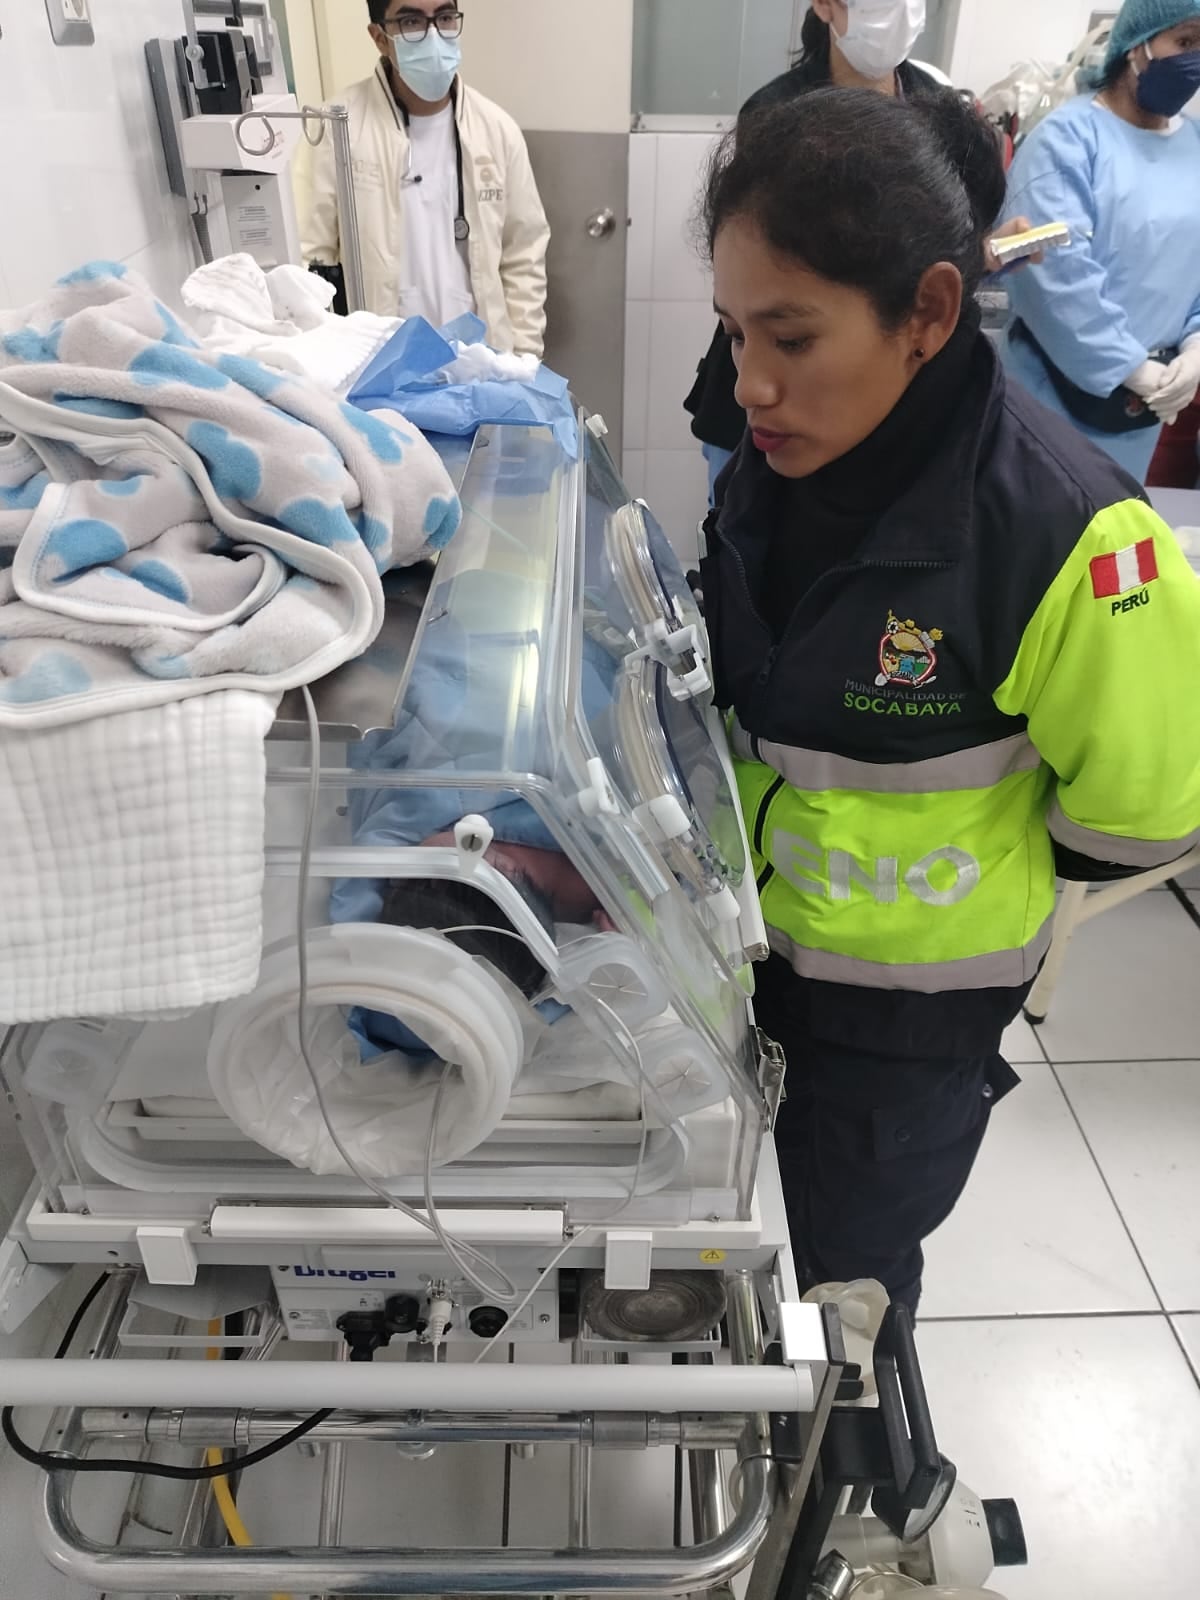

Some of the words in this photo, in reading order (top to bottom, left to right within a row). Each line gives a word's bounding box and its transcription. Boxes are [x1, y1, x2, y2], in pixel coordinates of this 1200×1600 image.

[1111, 587, 1150, 617] PERÚ
[843, 691, 961, 716] SOCABAYA
[844, 679, 946, 701] MUNICIPALIDAD
[948, 692, 966, 700] DE
[772, 828, 981, 907] ENO
